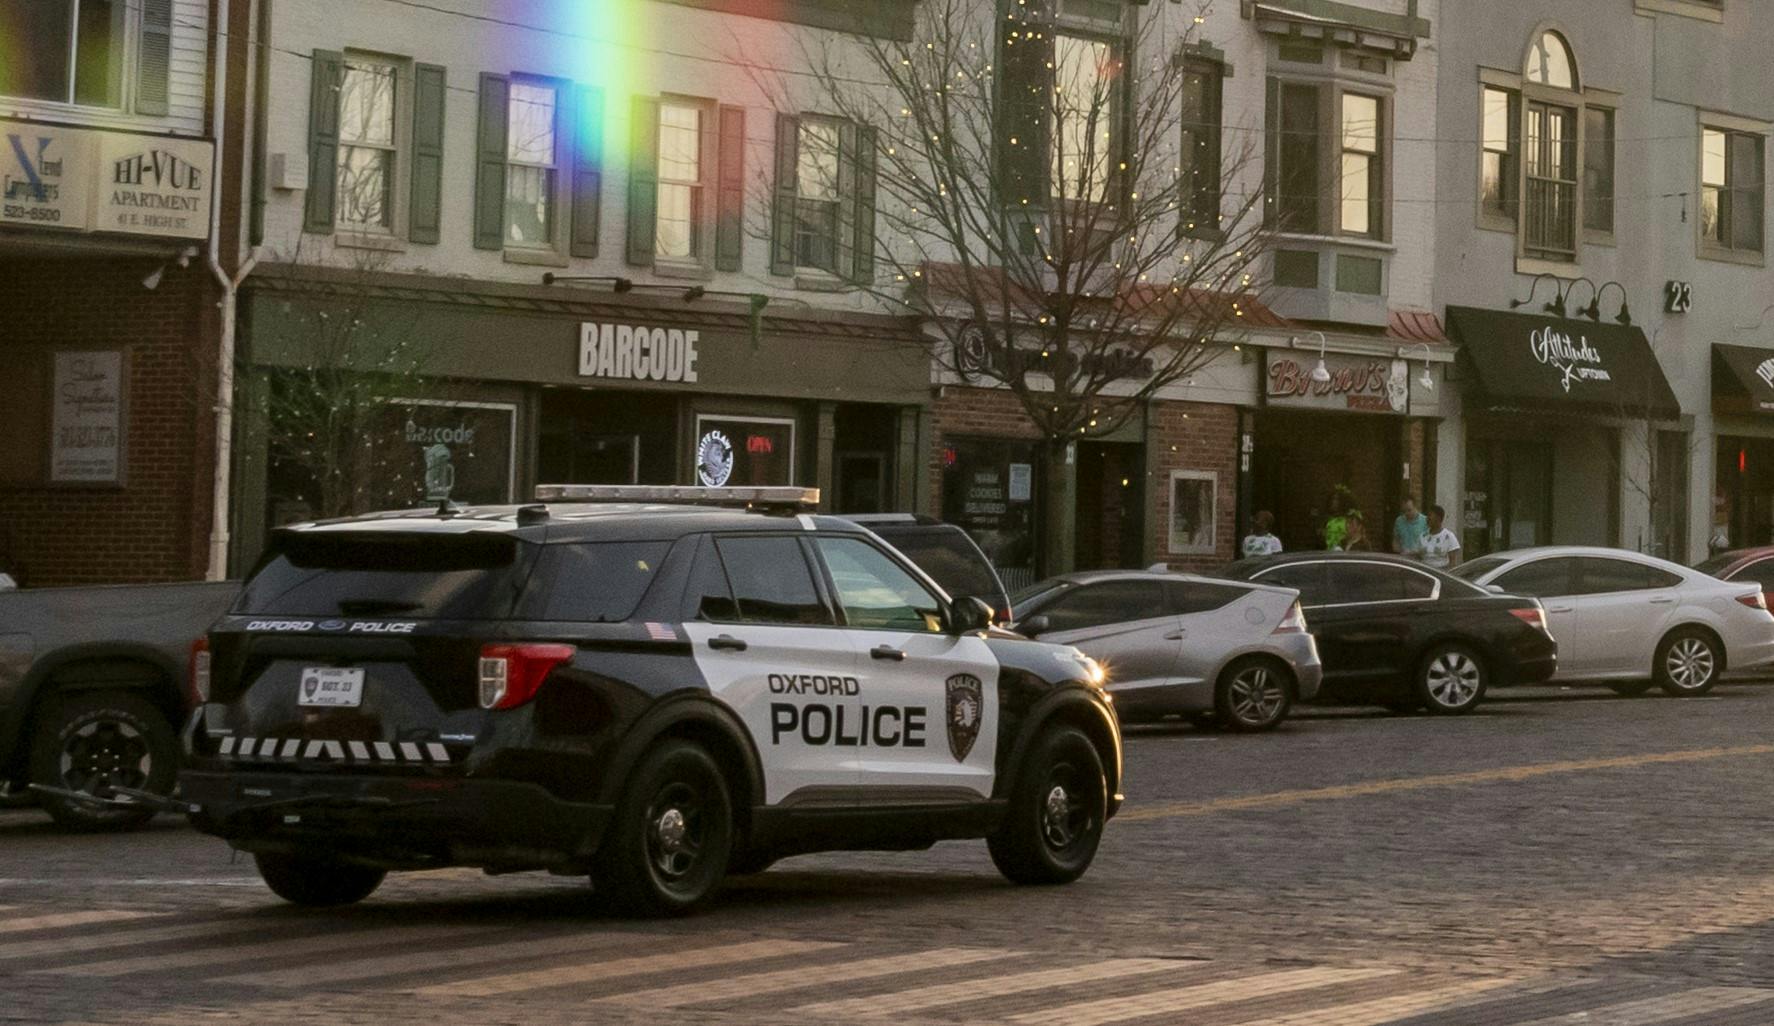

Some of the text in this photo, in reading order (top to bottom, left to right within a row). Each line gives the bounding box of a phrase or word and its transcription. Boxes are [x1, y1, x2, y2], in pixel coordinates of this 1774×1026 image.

[114, 151, 201, 190] HI-VUE
[111, 190, 201, 211] APARTMENT
[1671, 282, 1693, 313] 23
[579, 322, 699, 382] BARCODE
[246, 621, 417, 632] OXFORD POLICE
[768, 674, 860, 696] OXFORD
[948, 676, 978, 692] POLICE
[770, 702, 927, 747] POLICE
